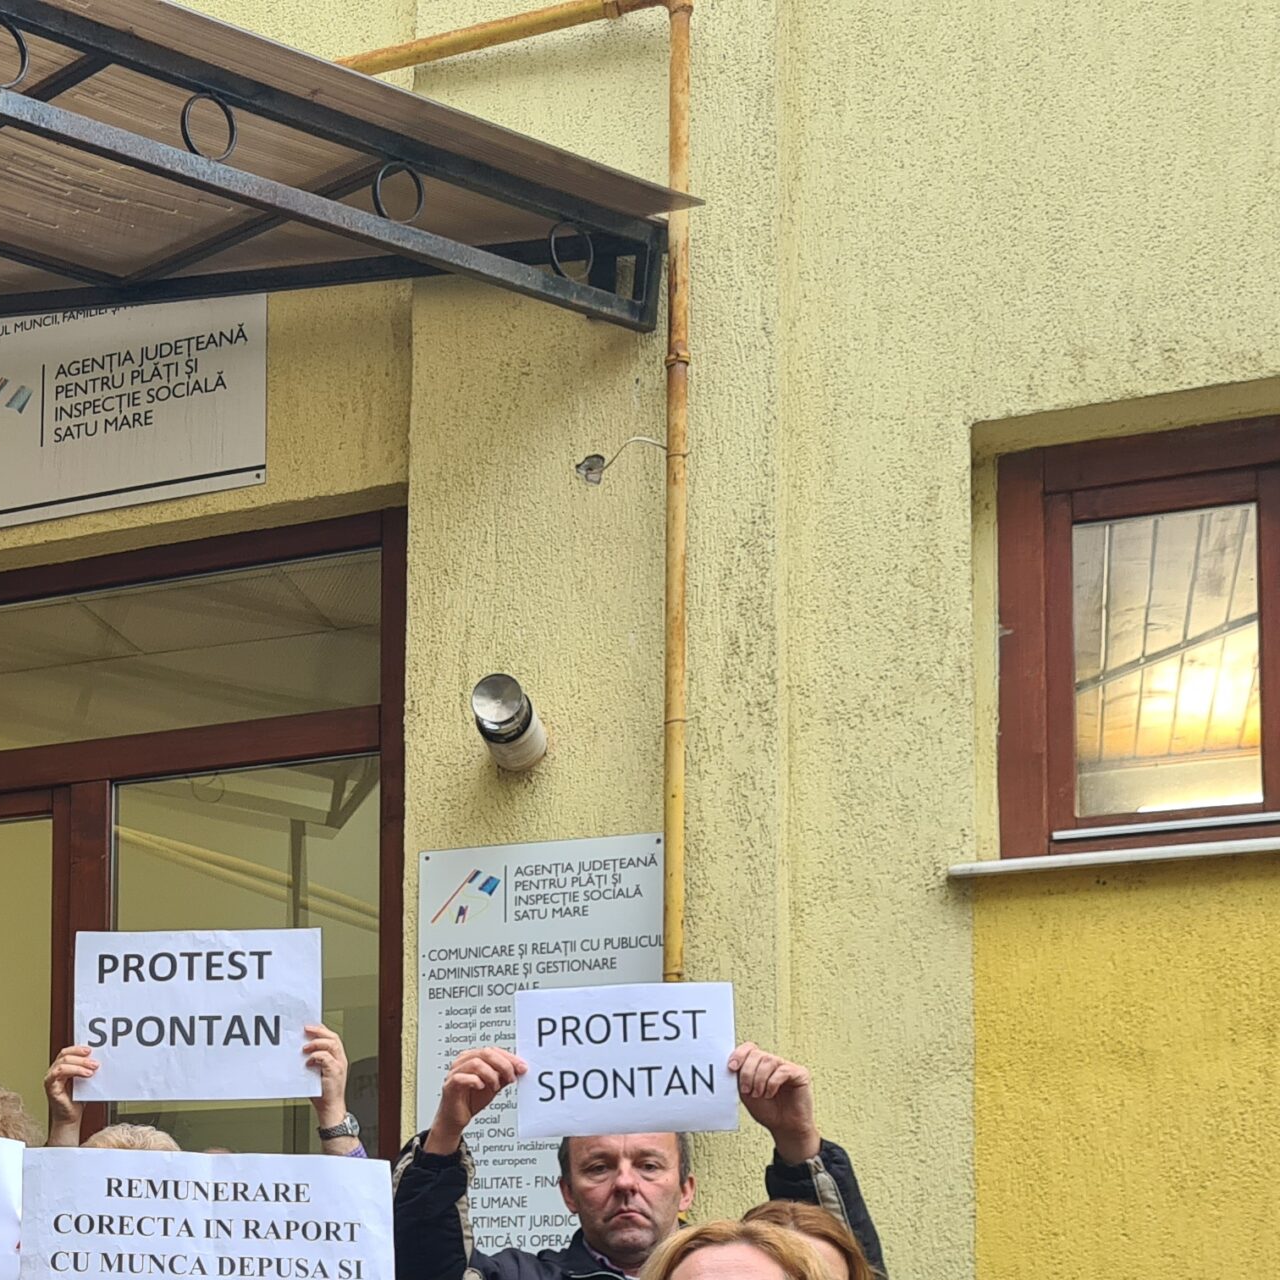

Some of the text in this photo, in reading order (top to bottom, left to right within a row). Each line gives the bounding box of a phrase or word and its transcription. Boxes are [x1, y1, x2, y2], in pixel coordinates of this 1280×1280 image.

[14, 315, 59, 333] MUNCII,
[55, 323, 248, 379] AGENȚIA JUDEȚEANĂ
[55, 358, 198, 400] PENTRU PLĂȚI ȘI
[55, 371, 227, 422] INSPECȚIE SOCIALĂ
[54, 410, 152, 443] SATU MARE
[515, 877, 567, 891] PENTRU
[583, 885, 643, 901] SOCIALĂ
[514, 905, 589, 921] SATU MARE
[428, 945, 515, 962] COMUNICARE
[580, 939, 600, 951] CU
[98, 951, 272, 983] PROTEST
[428, 963, 519, 981] ADMINISTRARE
[536, 958, 617, 974] GESTIONARE
[428, 985, 484, 1000] BENEFICII
[480, 1005, 491, 1013] de
[495, 1005, 511, 1013] stat
[88, 1015, 280, 1048] SPONTAN
[480, 1019, 511, 1030] pentru
[537, 1010, 706, 1047] PROTEST
[480, 1033, 491, 1041] de
[537, 1064, 714, 1102] SPONTAN
[475, 1115, 500, 1124] social
[488, 1128, 515, 1137] ONG
[483, 1143, 513, 1154] pentru
[492, 1157, 537, 1167] europene
[106, 1178, 310, 1203] REMUNERARE
[481, 1196, 528, 1208] UMANE
[53, 1213, 361, 1243] CORECTA IN RAPORT
[529, 1215, 577, 1231] JURIDIC
[51, 1251, 363, 1280] CU MUNCA DEPUSA SI
